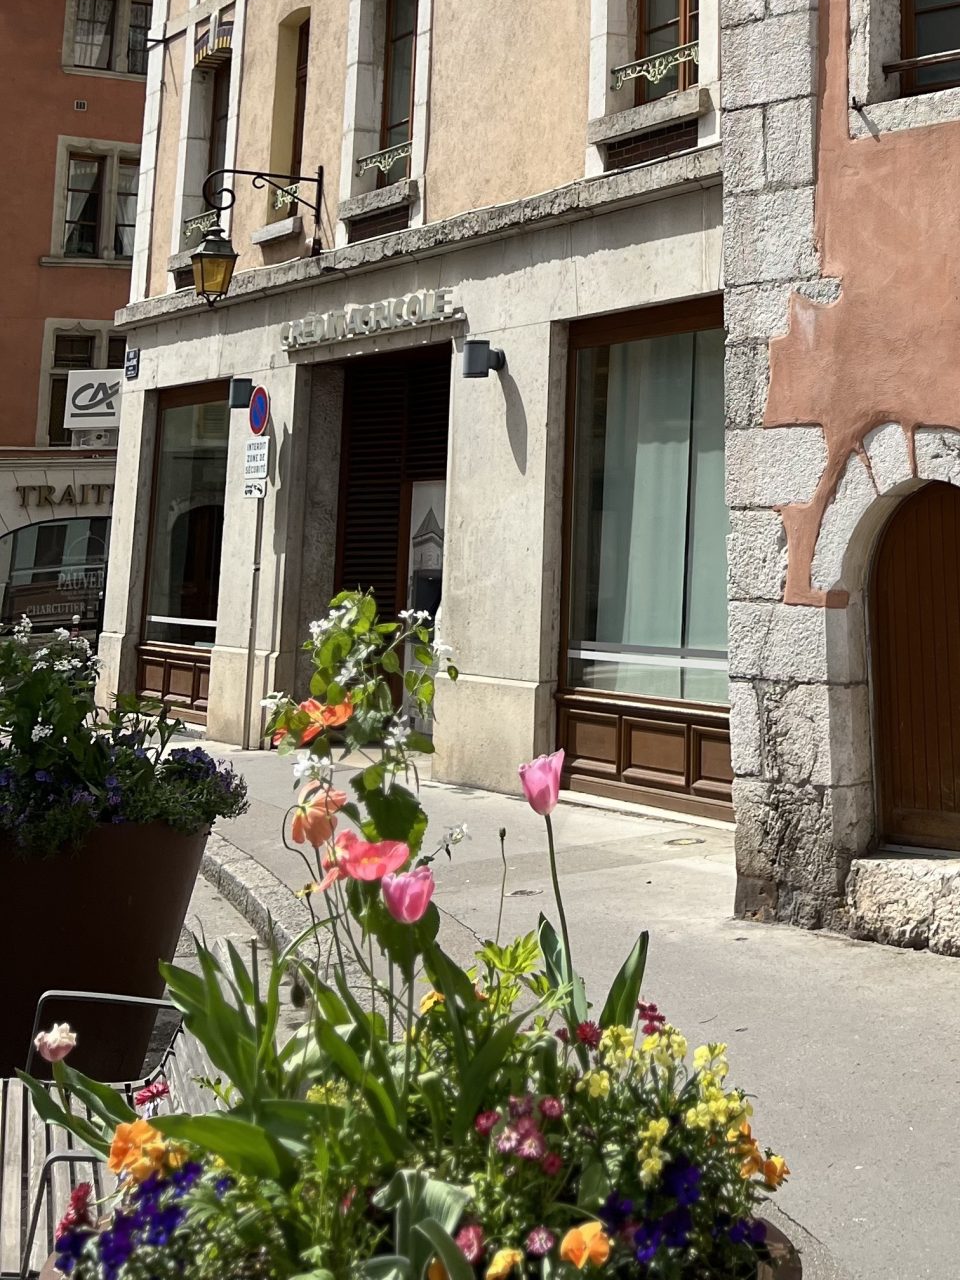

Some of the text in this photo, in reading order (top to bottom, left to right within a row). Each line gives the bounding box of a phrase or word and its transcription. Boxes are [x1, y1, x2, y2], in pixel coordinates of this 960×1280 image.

[345, 290, 454, 334] AGRICOLE
[247, 442, 266, 451] INTERDIT
[247, 453, 265, 462] ZONE DE
[245, 464, 266, 474] SÉCURITÉ
[16, 484, 114, 507] TRAIT
[26, 602, 86, 616] CHARCUTIER
